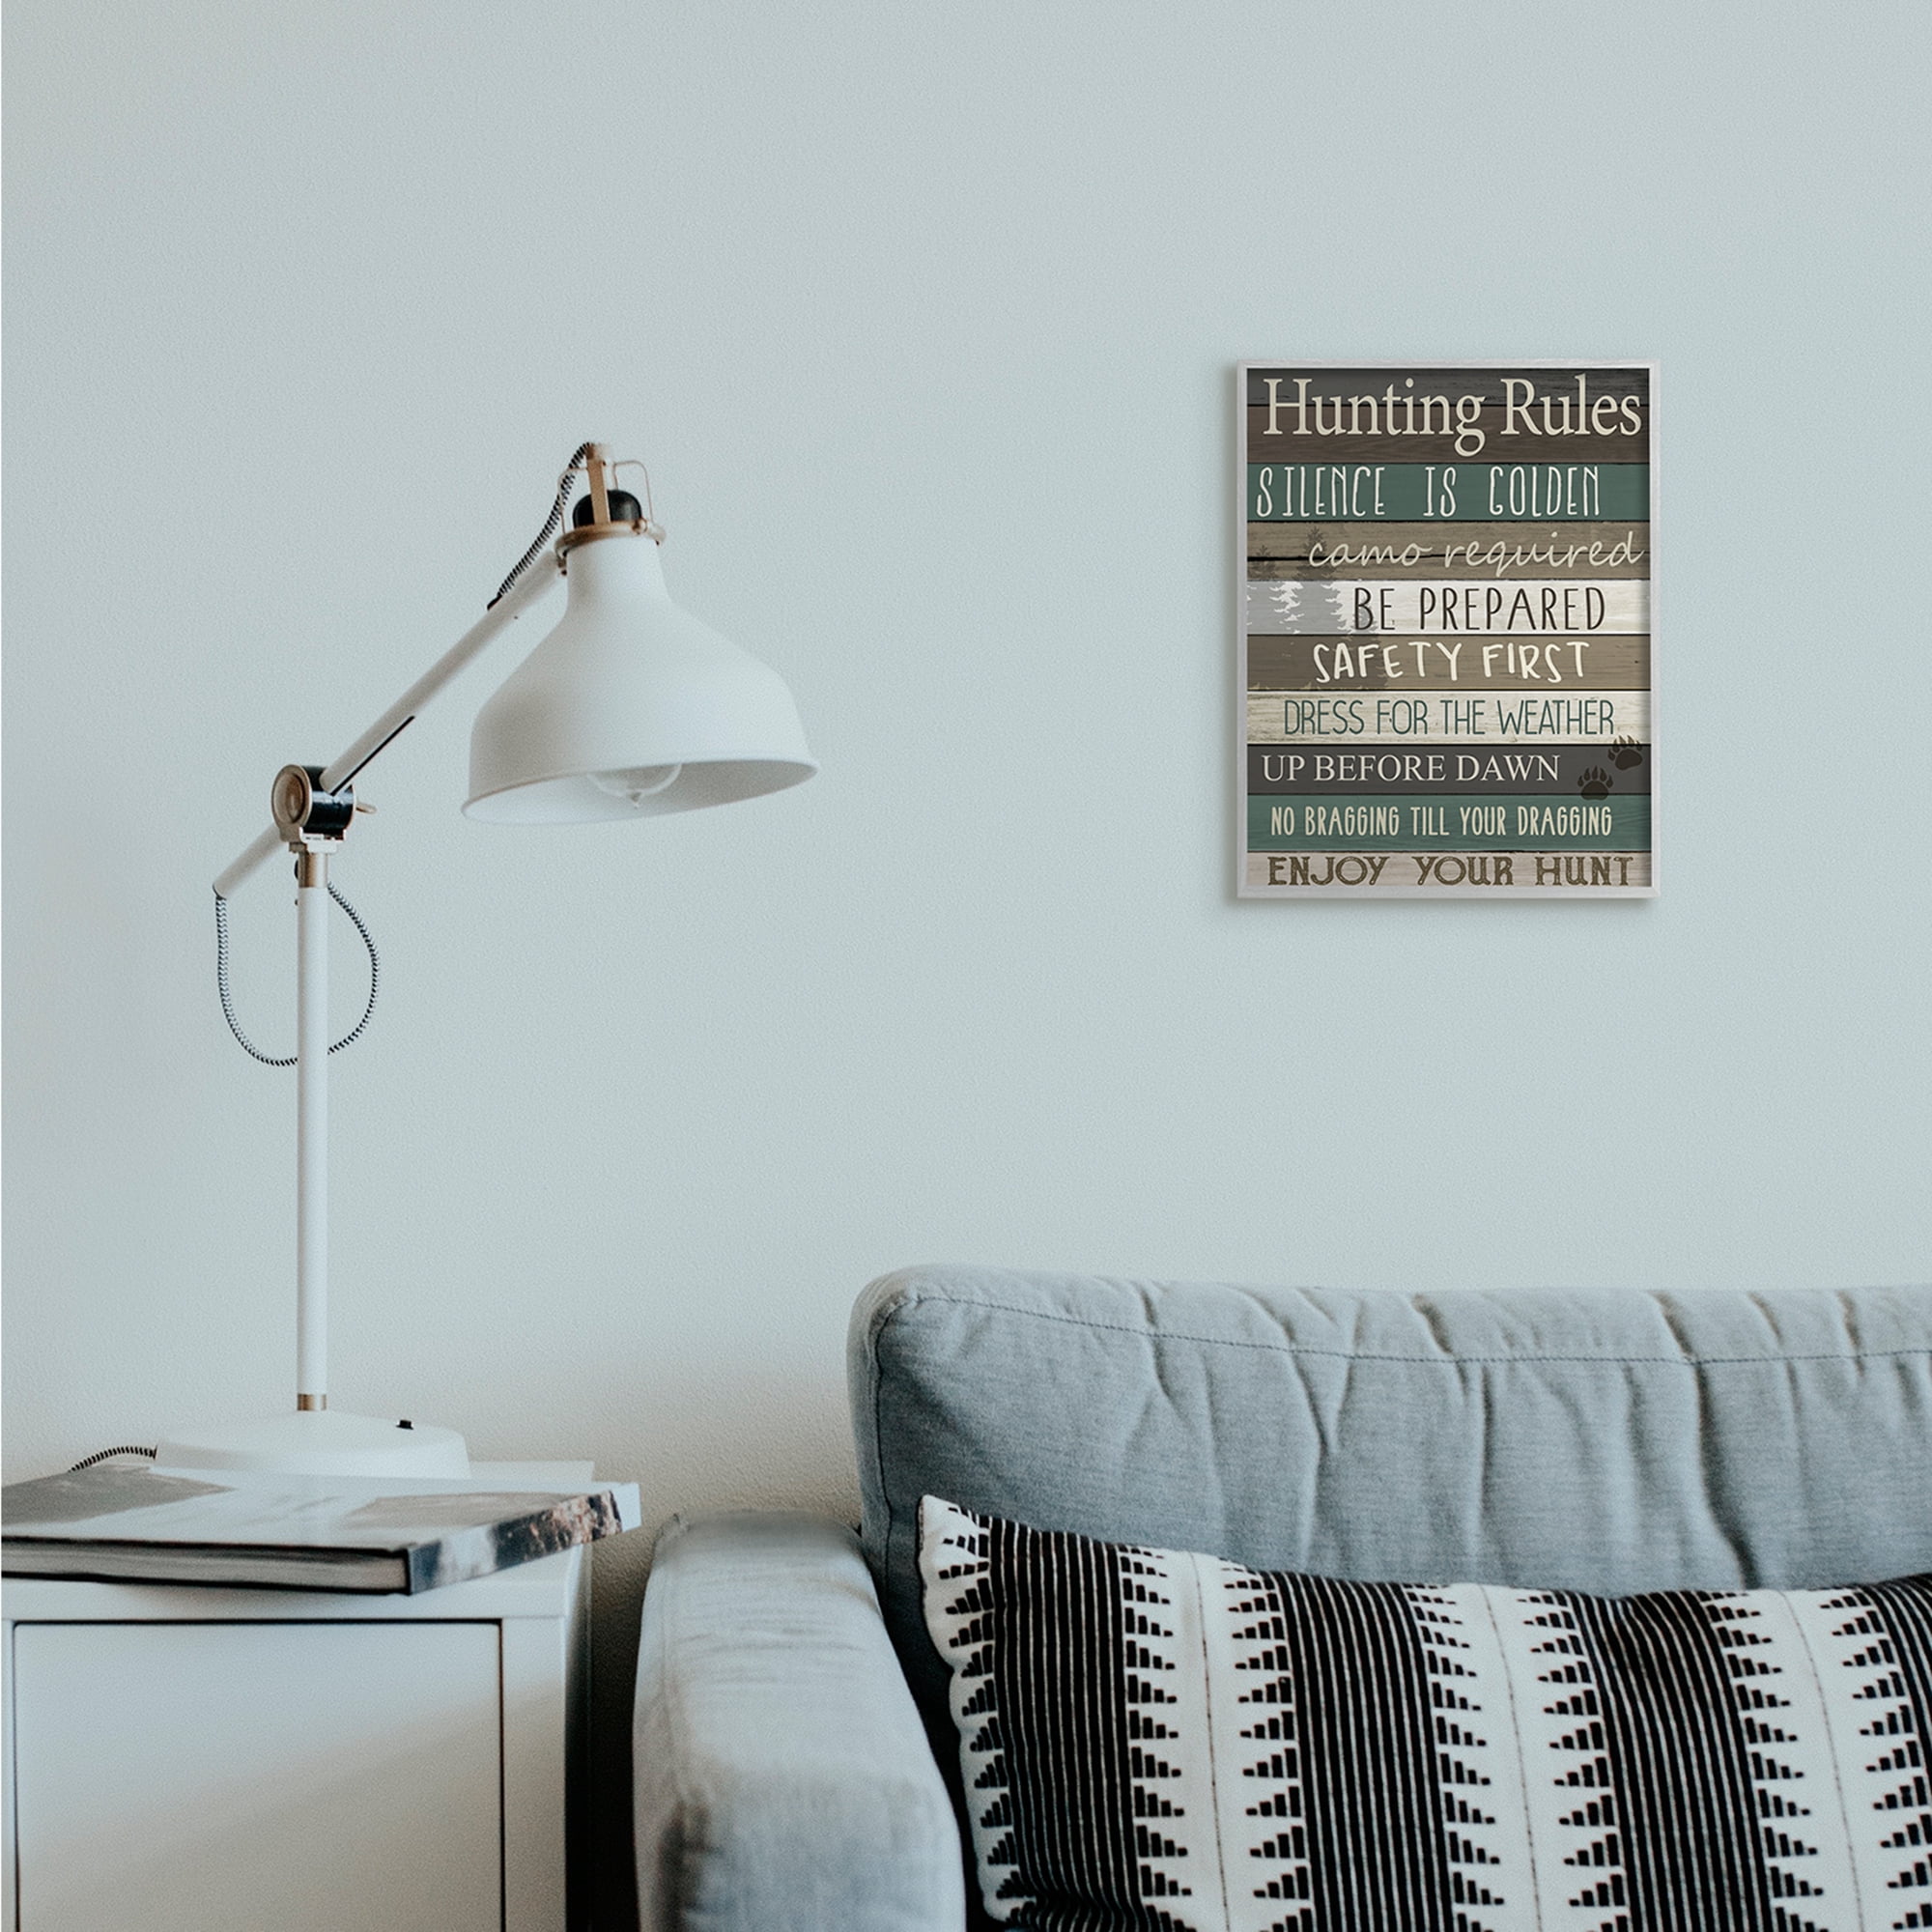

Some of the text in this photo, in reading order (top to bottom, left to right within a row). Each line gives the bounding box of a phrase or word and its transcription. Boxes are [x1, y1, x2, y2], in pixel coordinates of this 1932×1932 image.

[1263, 373, 1642, 457] Hunting Rules
[1256, 466, 1600, 517] SILENCE IS GOLDEN
[1308, 530, 1644, 578] camo required
[1354, 587, 1605, 632] BE PREPARED
[1312, 641, 1590, 684] SAFETY FIRST
[1283, 699, 1614, 735] DRESS FOR THE WEATHER
[1262, 754, 1561, 781] UP BEFORE DAWN
[1270, 806, 1613, 837] NO BRAGGING TILL YOUR DRAGGING
[1266, 856, 1634, 887] ENJOY YOUR HUNT
